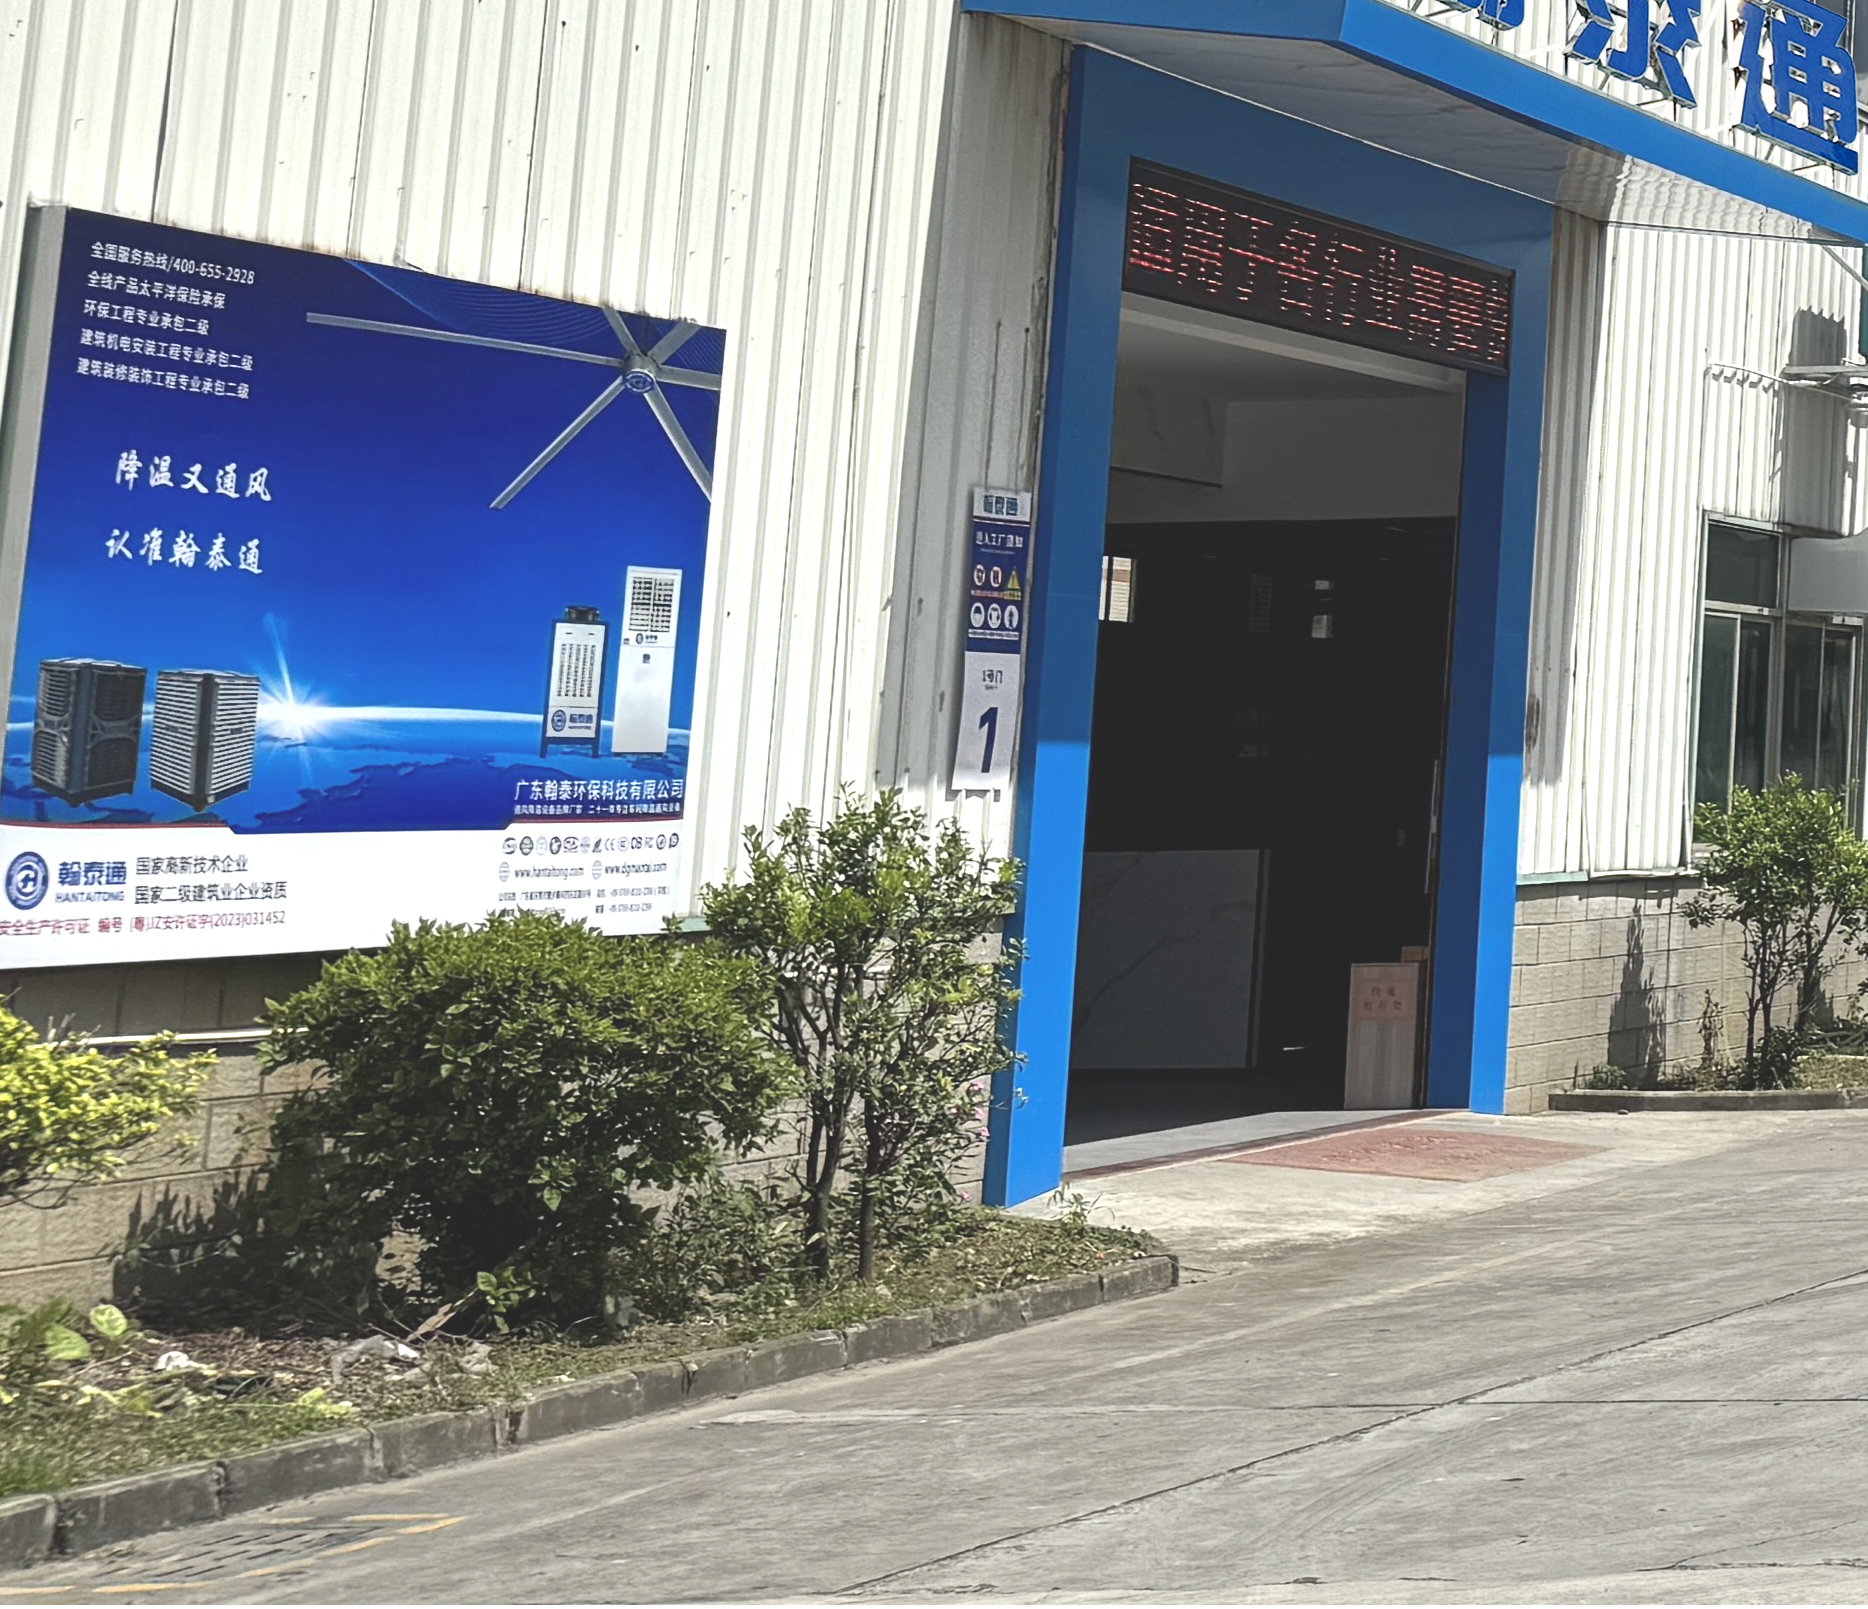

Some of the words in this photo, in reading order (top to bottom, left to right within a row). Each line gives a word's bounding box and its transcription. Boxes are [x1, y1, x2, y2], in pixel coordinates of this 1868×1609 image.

[83, 298, 209, 336] 环保工程专业承包二级
[80, 327, 253, 371] 建筑机电安装工程专业承包二级
[76, 356, 249, 399] 建筑装修装饰工程专业承包二级
[115, 448, 272, 501] 降温又通风
[105, 527, 263, 574] 认准翰泰通
[979, 707, 998, 773] 1
[514, 779, 684, 801] 广东翰泰环保科技有限公司
[57, 861, 127, 887] 翰泰通
[136, 855, 248, 875] 国家高新技术企业
[135, 881, 287, 904] 国家二级建筑业企业资质
